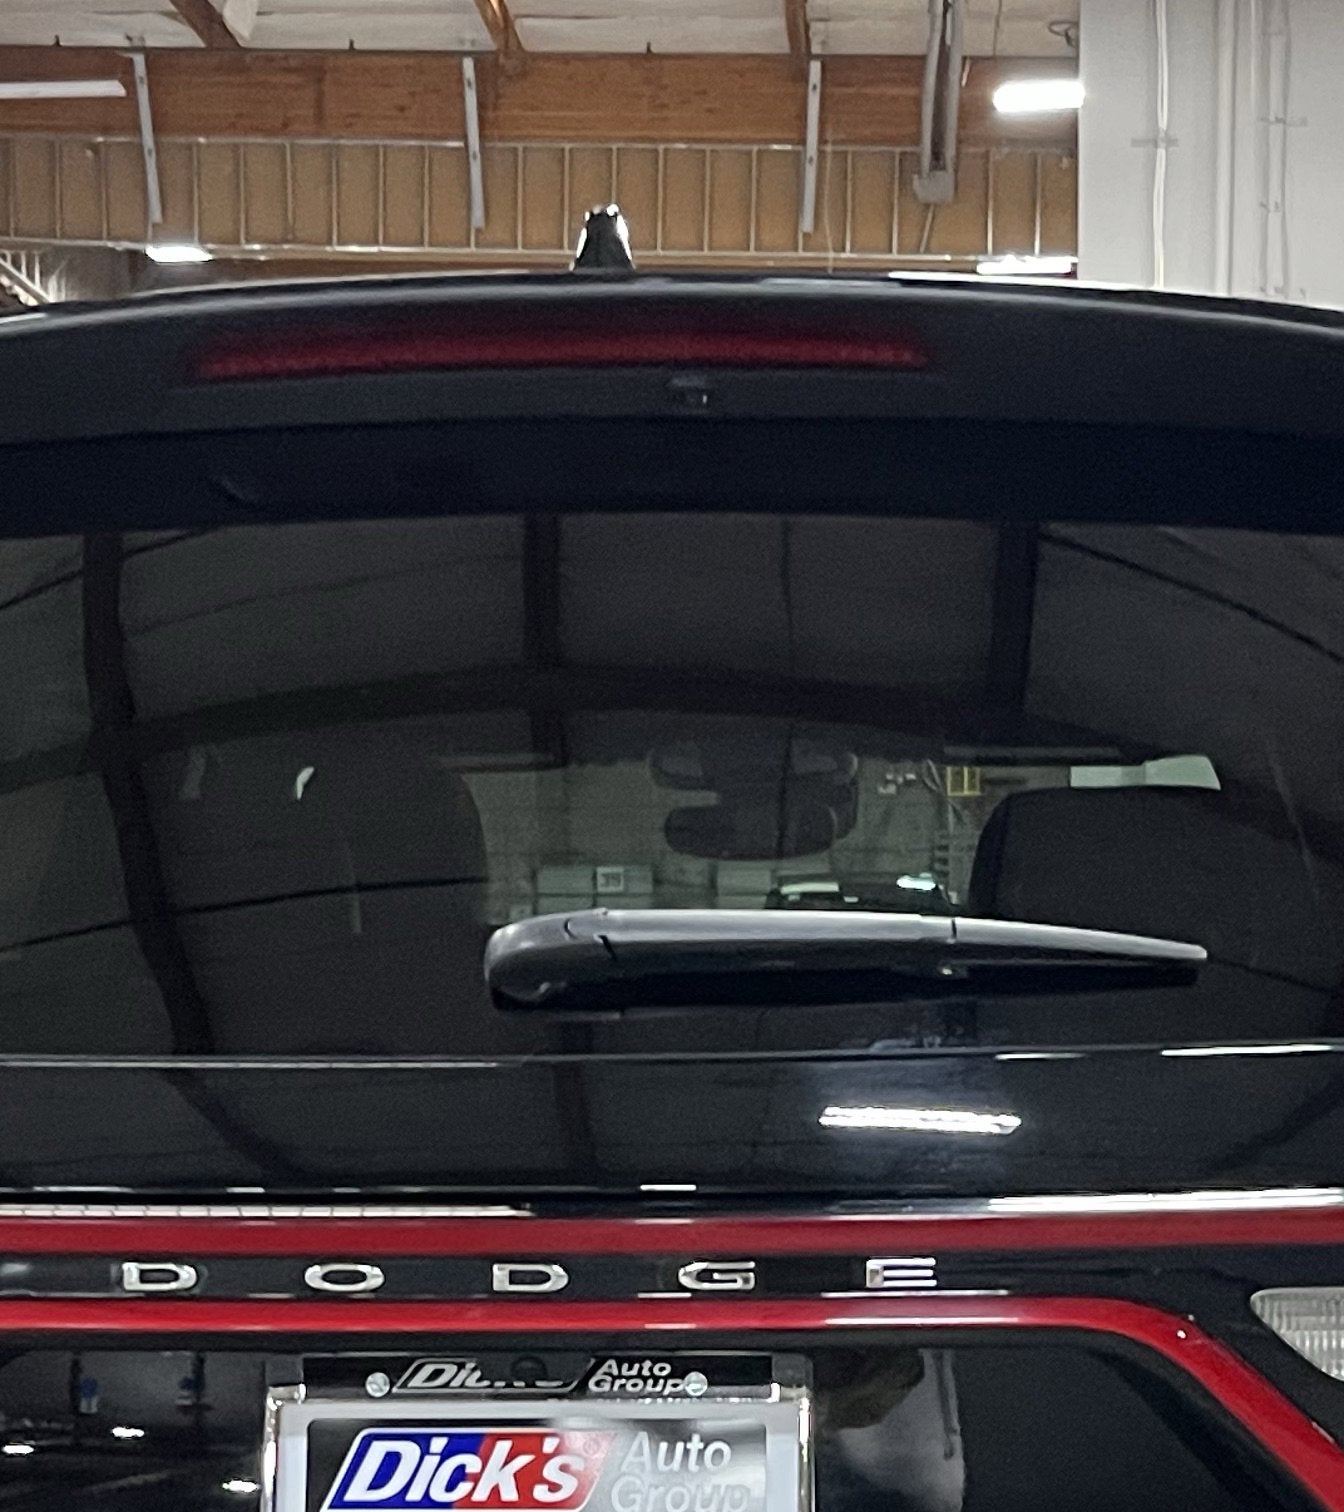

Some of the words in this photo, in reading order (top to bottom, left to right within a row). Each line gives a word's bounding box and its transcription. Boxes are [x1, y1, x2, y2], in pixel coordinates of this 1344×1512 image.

[121, 1261, 938, 1292] DODGE
[600, 1358, 672, 1377] Auto
[343, 1436, 582, 1502] Dick's
[619, 1432, 732, 1474] Auto
